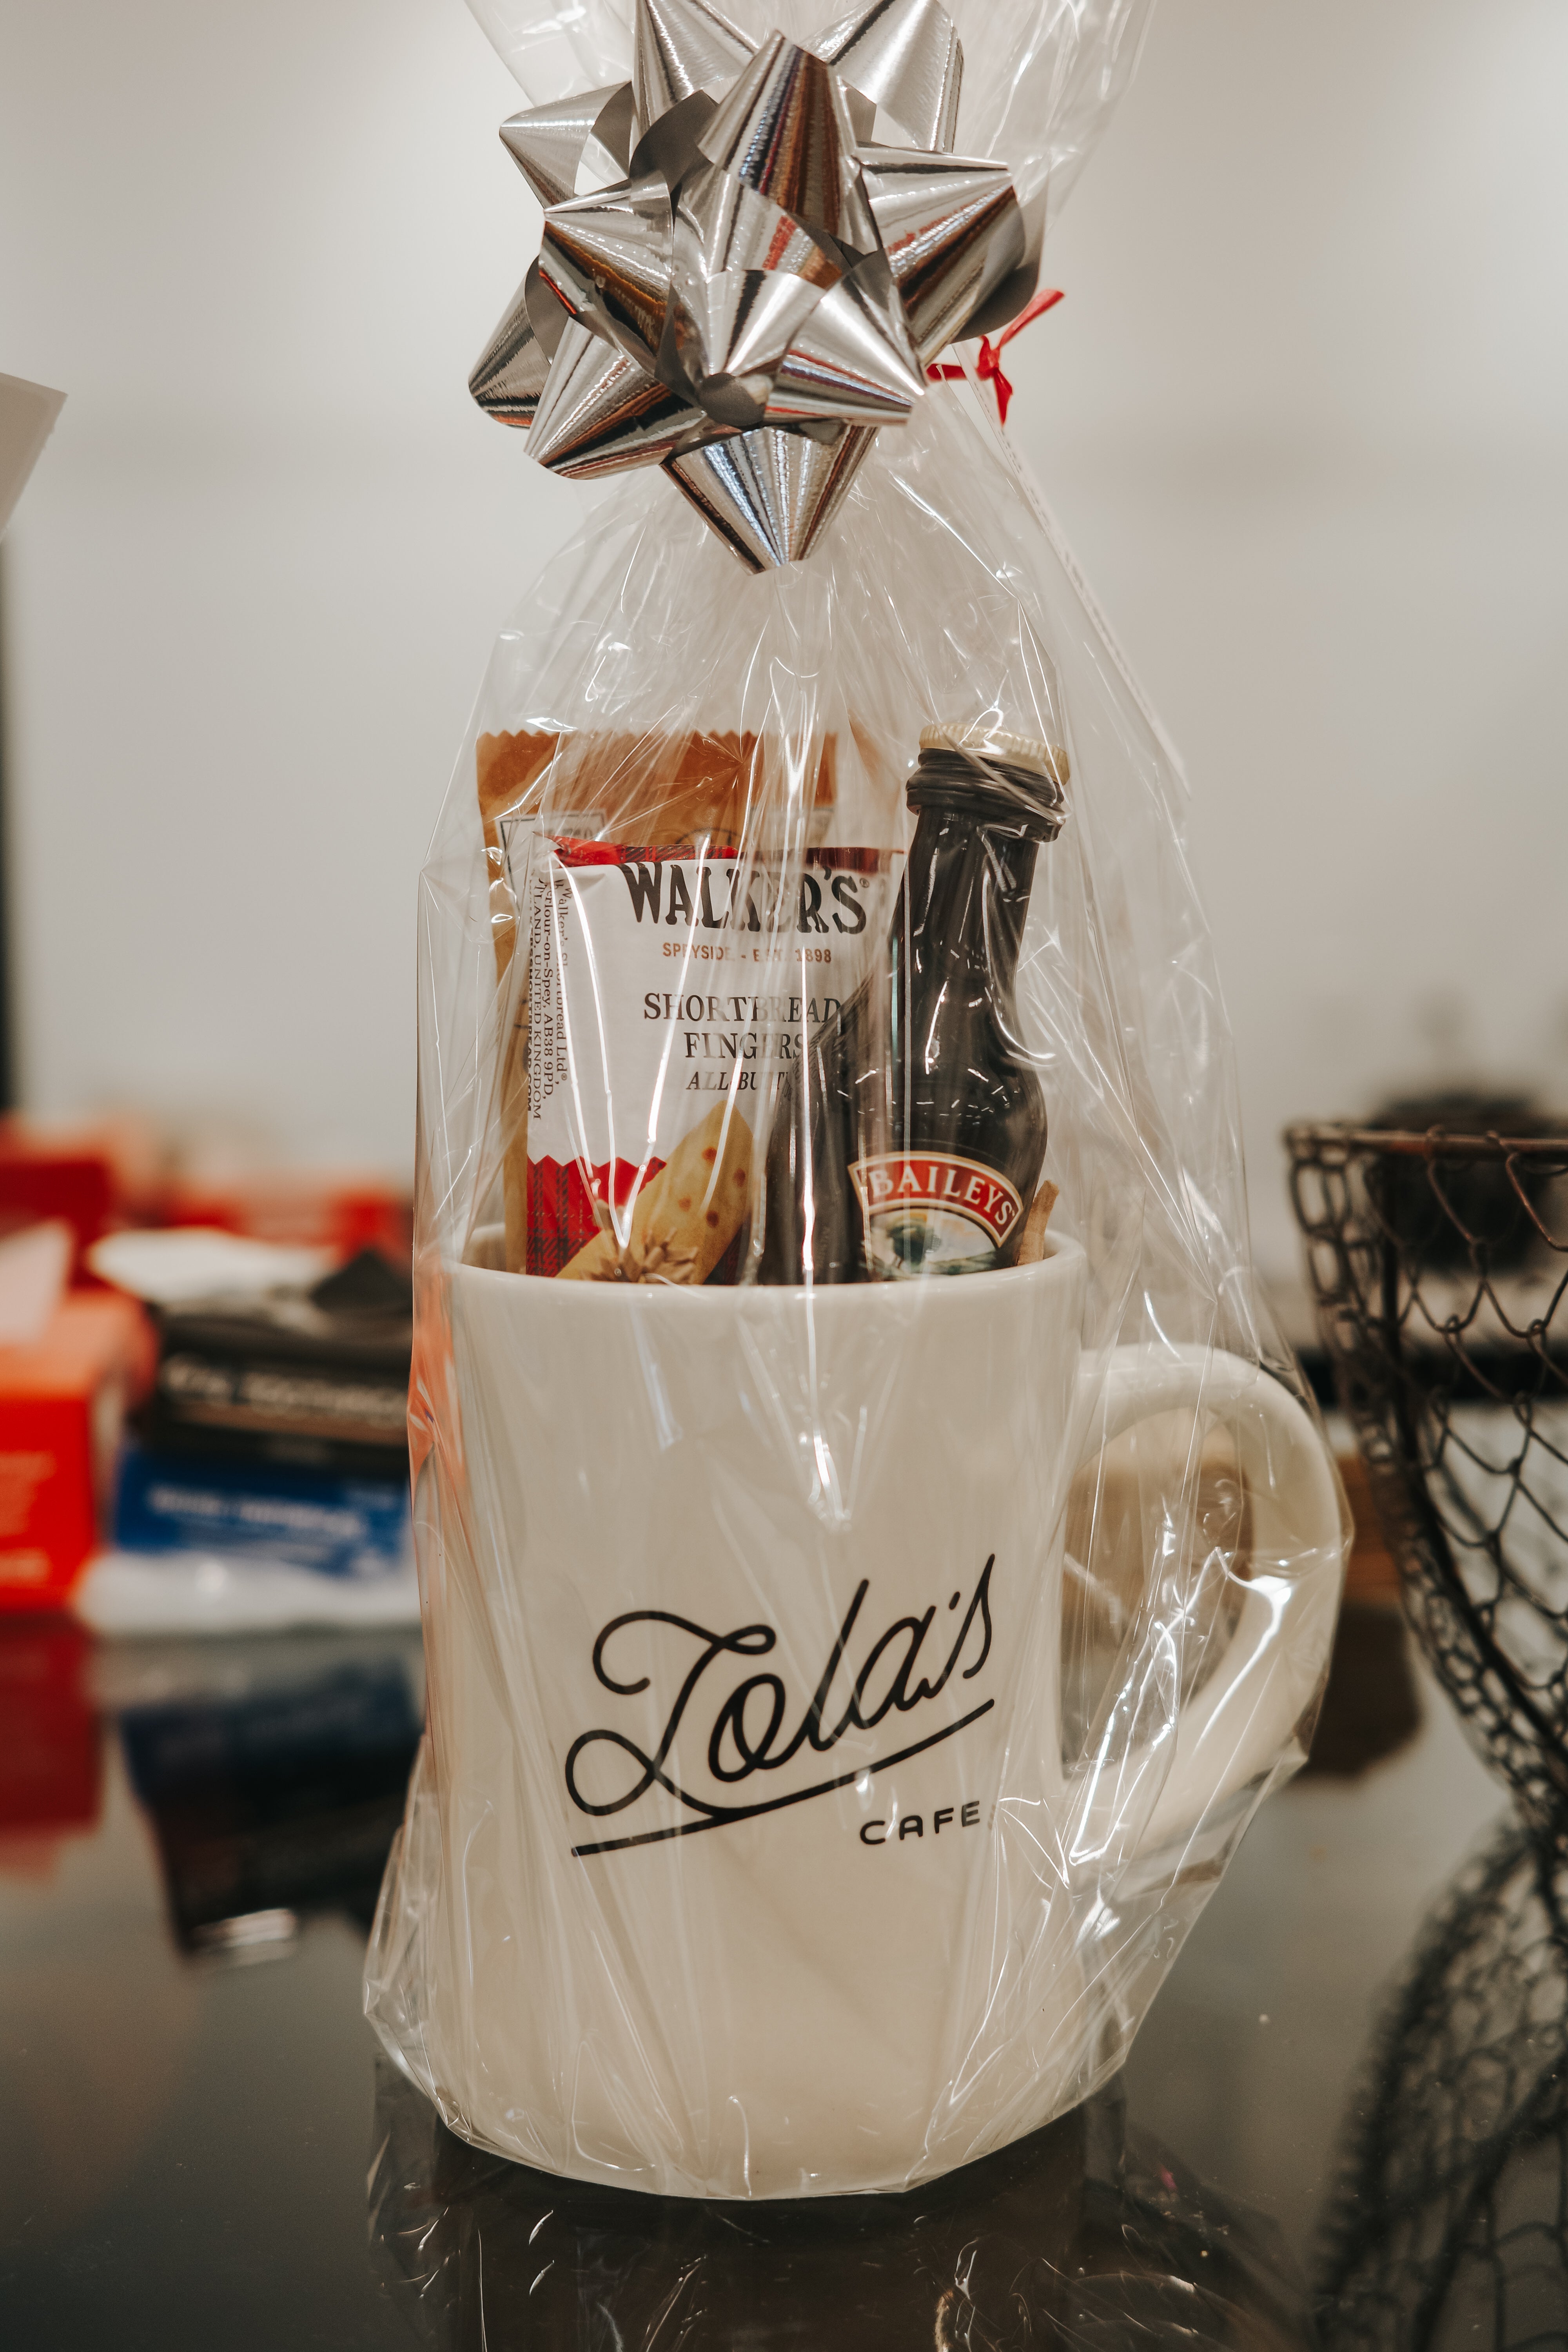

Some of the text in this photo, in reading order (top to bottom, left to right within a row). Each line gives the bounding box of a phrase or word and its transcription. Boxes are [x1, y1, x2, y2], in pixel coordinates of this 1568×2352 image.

[795, 948, 832, 964] 1898
[533, 1030, 541, 1120] KINGDOM
[542, 1013, 554, 1099] AB38 9PD,
[686, 1071, 729, 1090] ALL
[868, 1165, 1013, 1225] BAILEYS
[860, 1800, 980, 1845] CAFE
